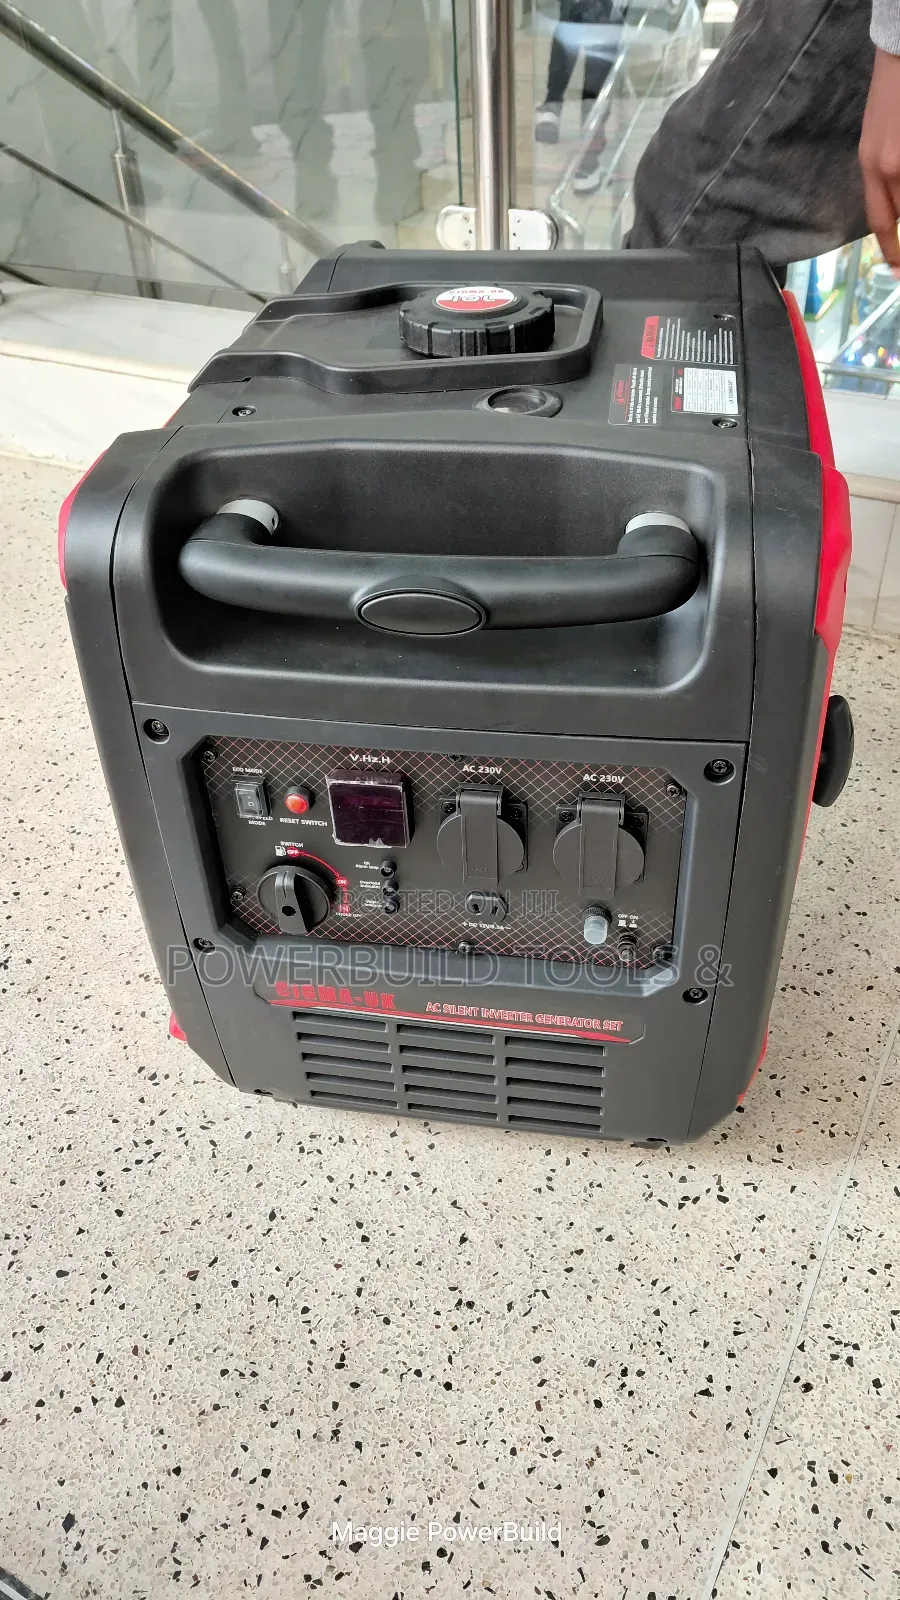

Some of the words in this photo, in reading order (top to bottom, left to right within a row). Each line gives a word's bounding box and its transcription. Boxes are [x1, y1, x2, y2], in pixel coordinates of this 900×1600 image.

[462, 764, 476, 773] AC
[478, 766, 503, 775] 230V
[582, 773, 597, 782] AC
[600, 774, 625, 784] 230V
[279, 817, 300, 825] RESET
[301, 819, 328, 827] SWITCH
[275, 980, 397, 1010] CIGMA-UK
[425, 1001, 442, 1013] AC
[442, 1003, 480, 1018] SILENT
[481, 1007, 534, 1024] INVERTER
[535, 1012, 601, 1030] GENERATOR
[603, 1019, 624, 1032] SET
